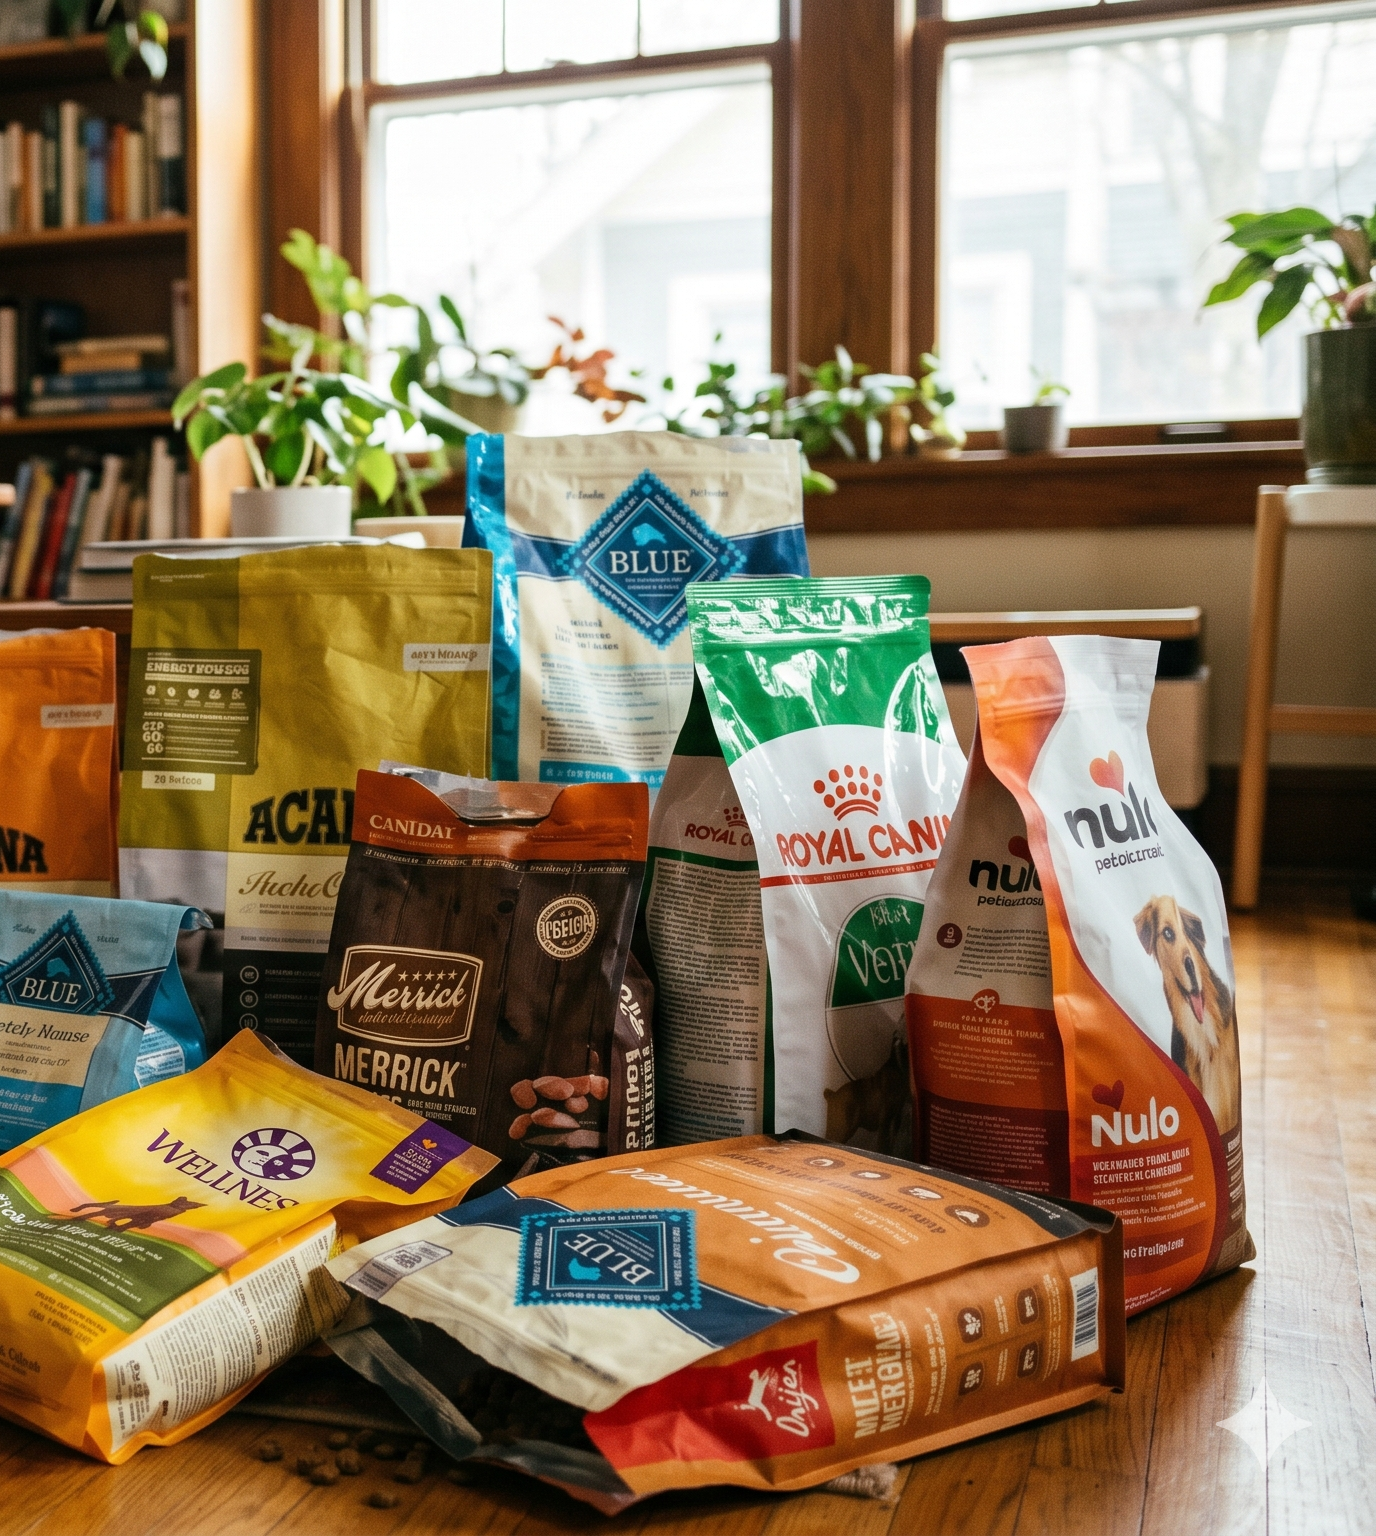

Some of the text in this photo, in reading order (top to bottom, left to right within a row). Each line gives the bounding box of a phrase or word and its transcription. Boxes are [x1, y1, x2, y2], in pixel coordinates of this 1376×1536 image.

[609, 550, 692, 575] BLUE
[684, 823, 737, 846] ROYAL
[776, 827, 866, 868] ROYAL
[19, 977, 82, 1005] BLUE
[327, 961, 467, 1012] Merrick
[334, 1043, 460, 1098] MERRICK
[1091, 1096, 1180, 1148] Nulo
[563, 1232, 656, 1285] BLUE
